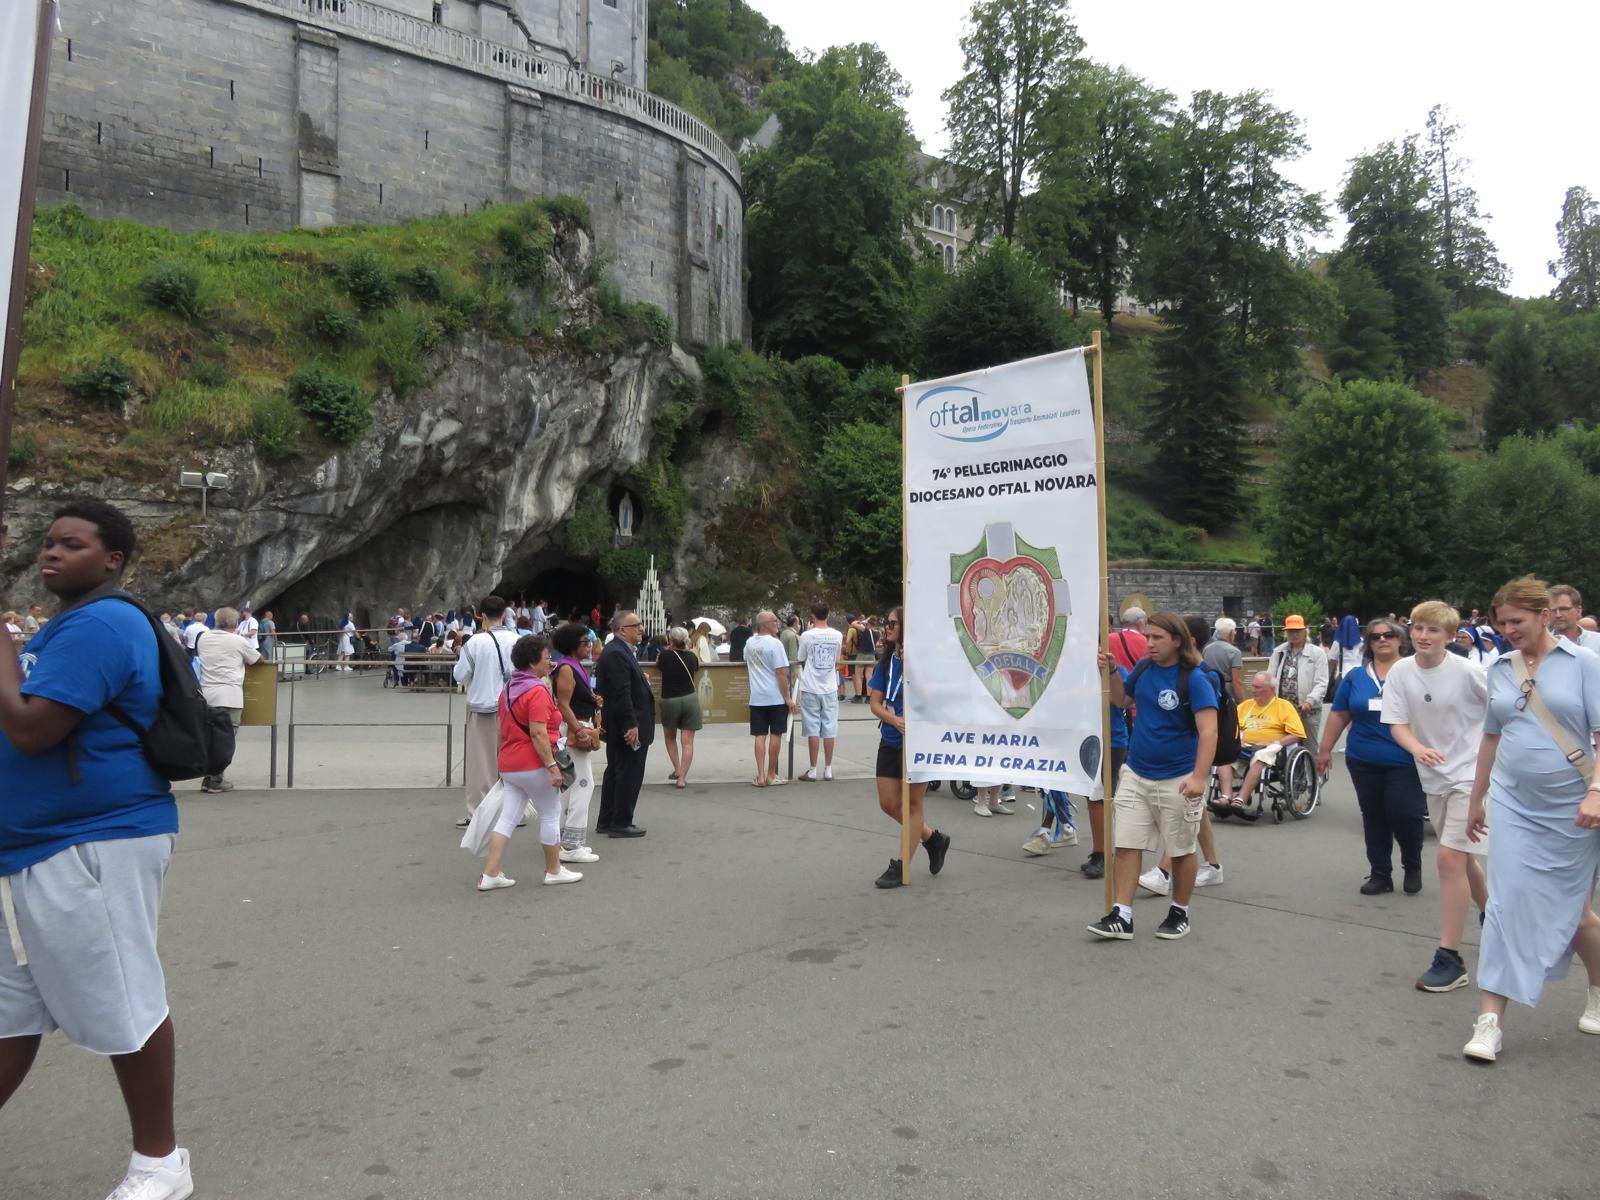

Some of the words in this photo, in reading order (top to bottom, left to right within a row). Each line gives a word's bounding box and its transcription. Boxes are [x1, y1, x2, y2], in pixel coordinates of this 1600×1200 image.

[1059, 408, 1081, 418] Lourdes
[954, 453, 1068, 478] PELLEGRINAGGIO
[909, 485, 985, 503] DIOCESANO
[988, 481, 1031, 496] OFTAL
[1034, 473, 1097, 492] NOVARA
[940, 731, 976, 744] AVE
[982, 733, 1040, 747] MARIA
[913, 752, 968, 766] PIENA
[974, 755, 994, 768] DI
[1000, 757, 1067, 773] GRAZIA
